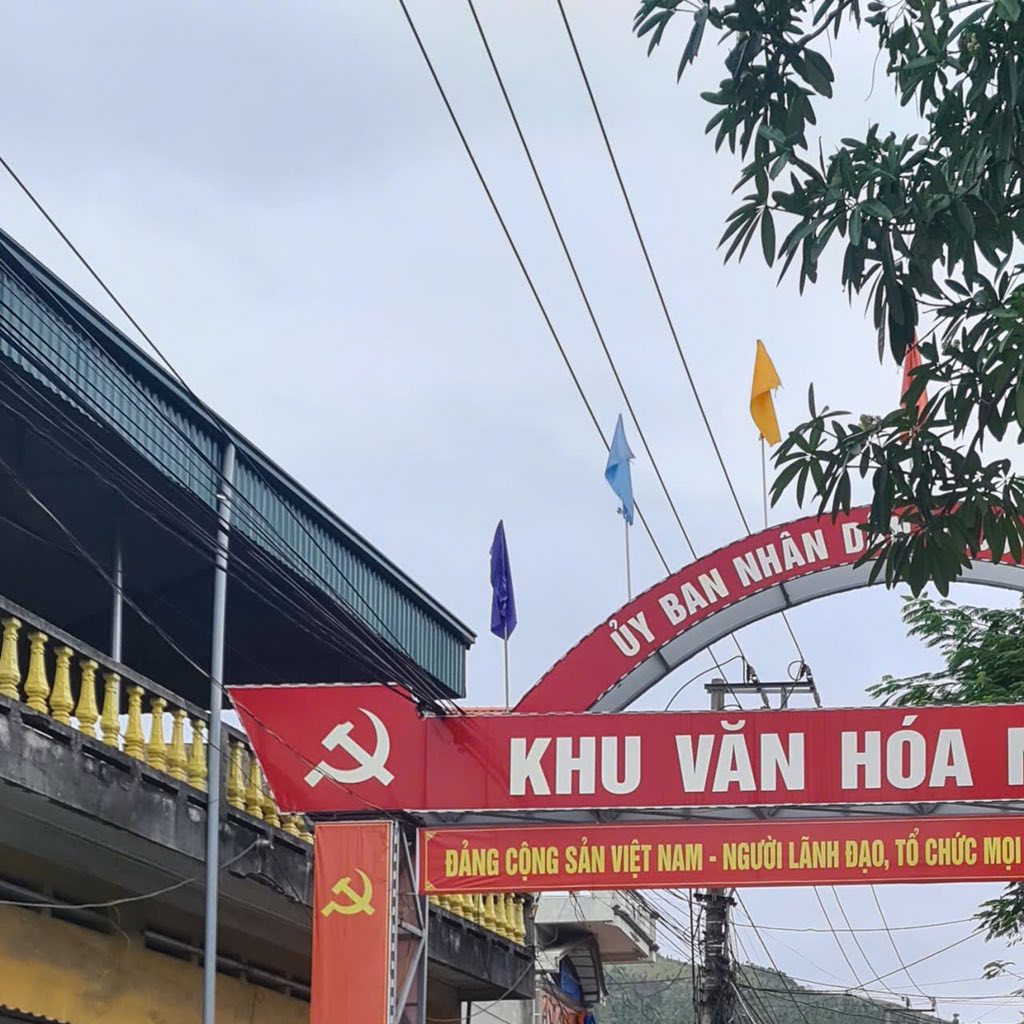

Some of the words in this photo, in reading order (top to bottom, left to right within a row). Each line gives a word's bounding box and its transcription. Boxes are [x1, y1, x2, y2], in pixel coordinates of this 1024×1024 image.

[609, 612, 655, 658] ỦY
[658, 568, 729, 626] BAN
[732, 530, 828, 587] NHÂN
[510, 735, 641, 796] KHU
[675, 719, 805, 792] VĂN
[841, 714, 974, 790] HÓA
[445, 840, 499, 877] ĐẢNG
[505, 842, 559, 881] CỘNG
[565, 836, 605, 874] SẢN
[611, 839, 652, 879] VIỆT
[657, 843, 702, 872] NAM
[723, 835, 782, 871] NGƯỜI
[789, 836, 839, 869] LÃNH
[845, 839, 889, 874] ĐẠO,
[895, 827, 920, 867] TỔ
[925, 831, 977, 866] CHỨC
[984, 837, 1021, 871] MỌI
